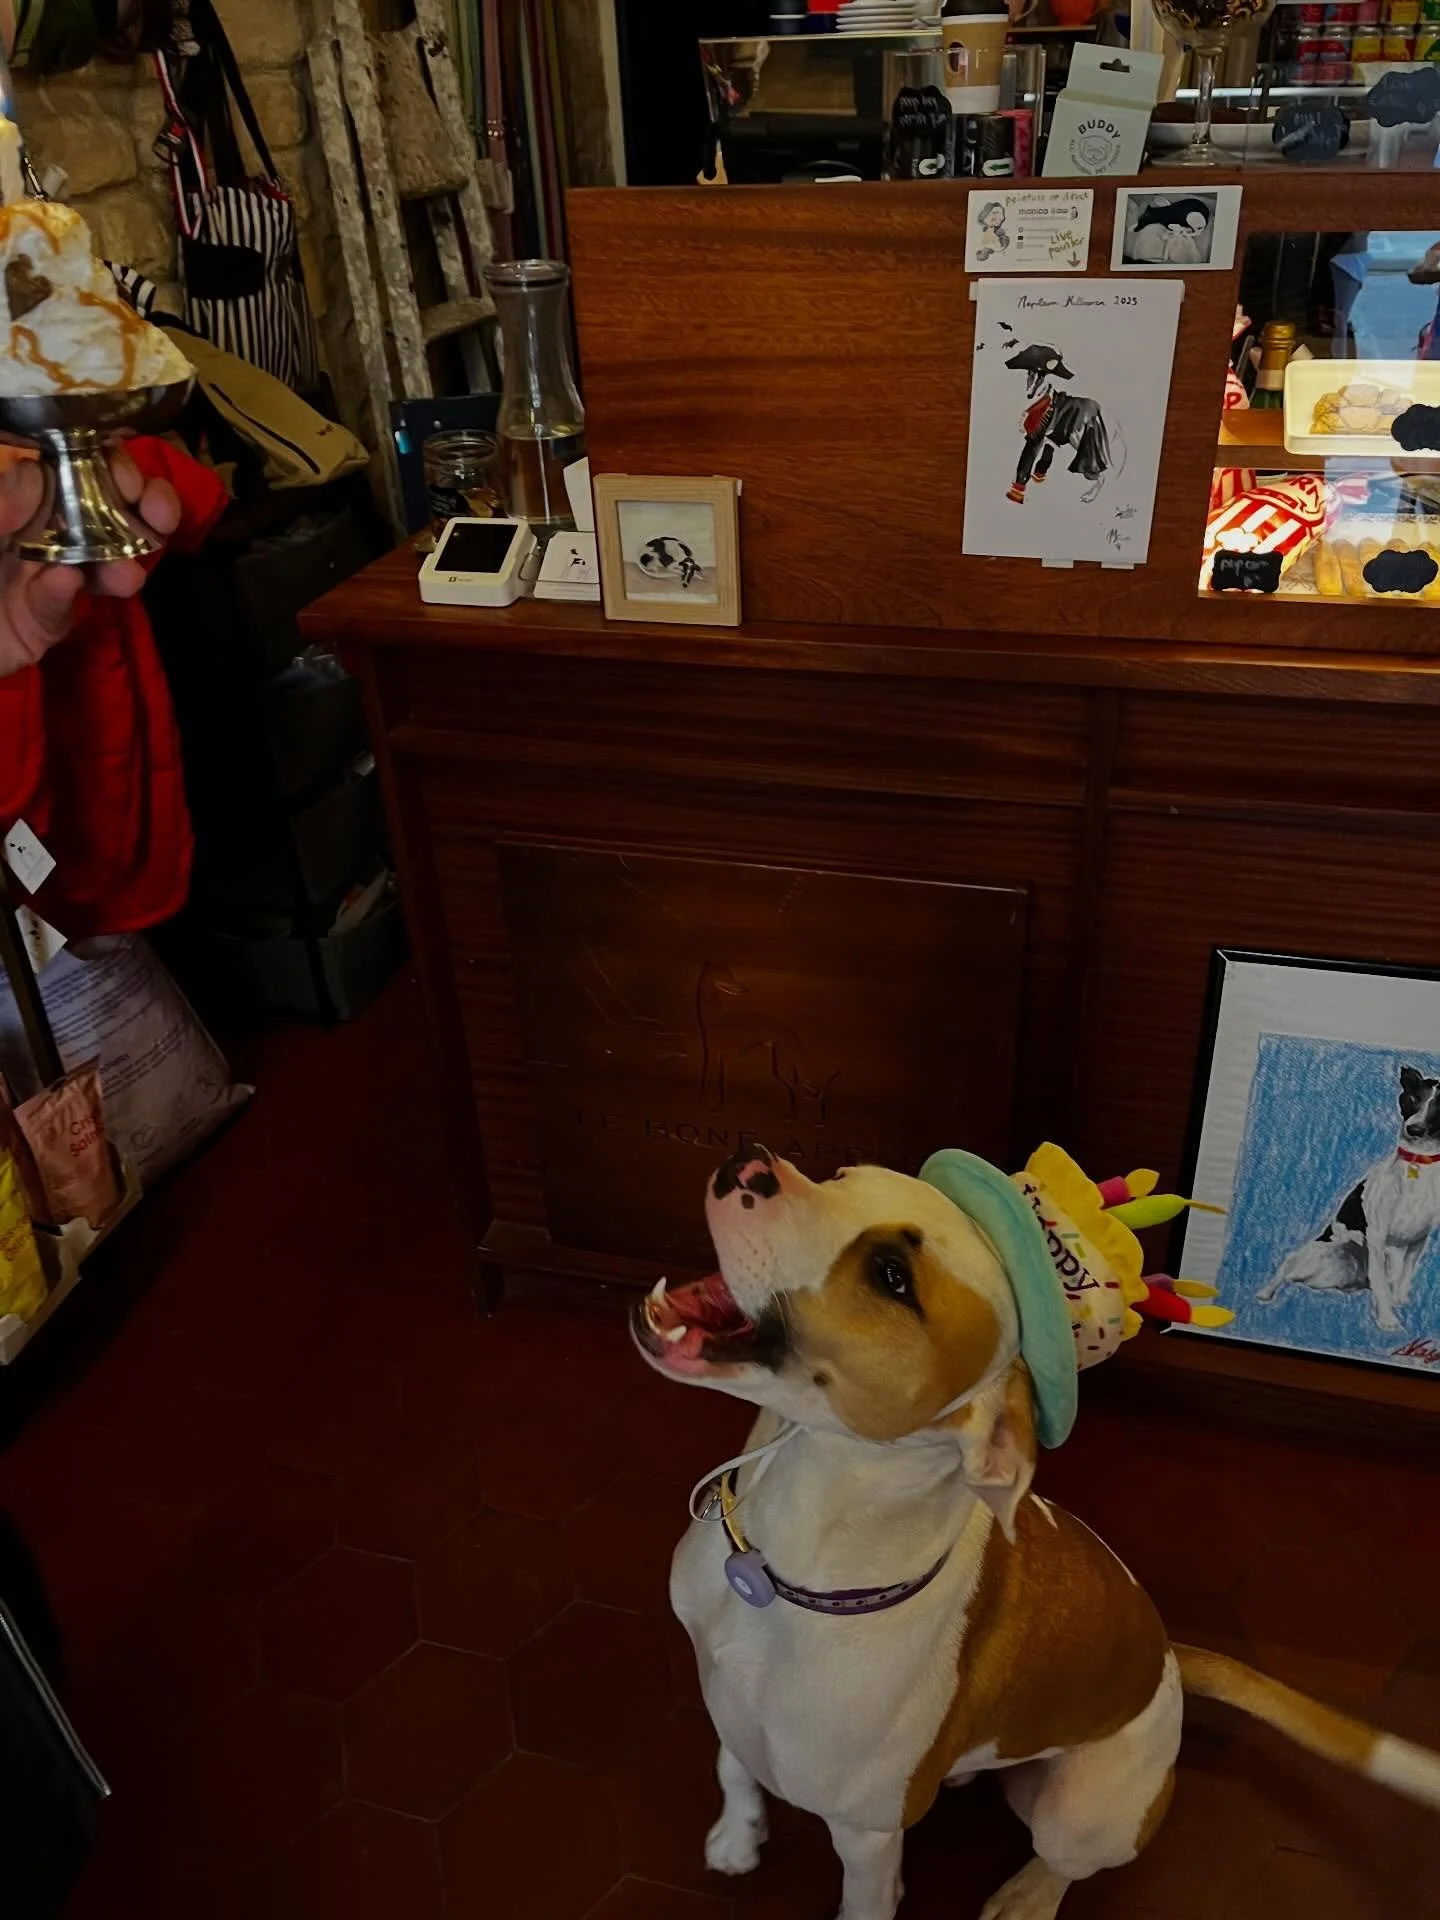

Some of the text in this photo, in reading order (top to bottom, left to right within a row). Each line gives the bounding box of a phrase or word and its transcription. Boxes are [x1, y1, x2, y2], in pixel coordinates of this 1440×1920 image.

[1078, 120, 1120, 139] BUDDY
[1113, 295, 1138, 306] 2025
[576, 1108, 618, 1131] LE
